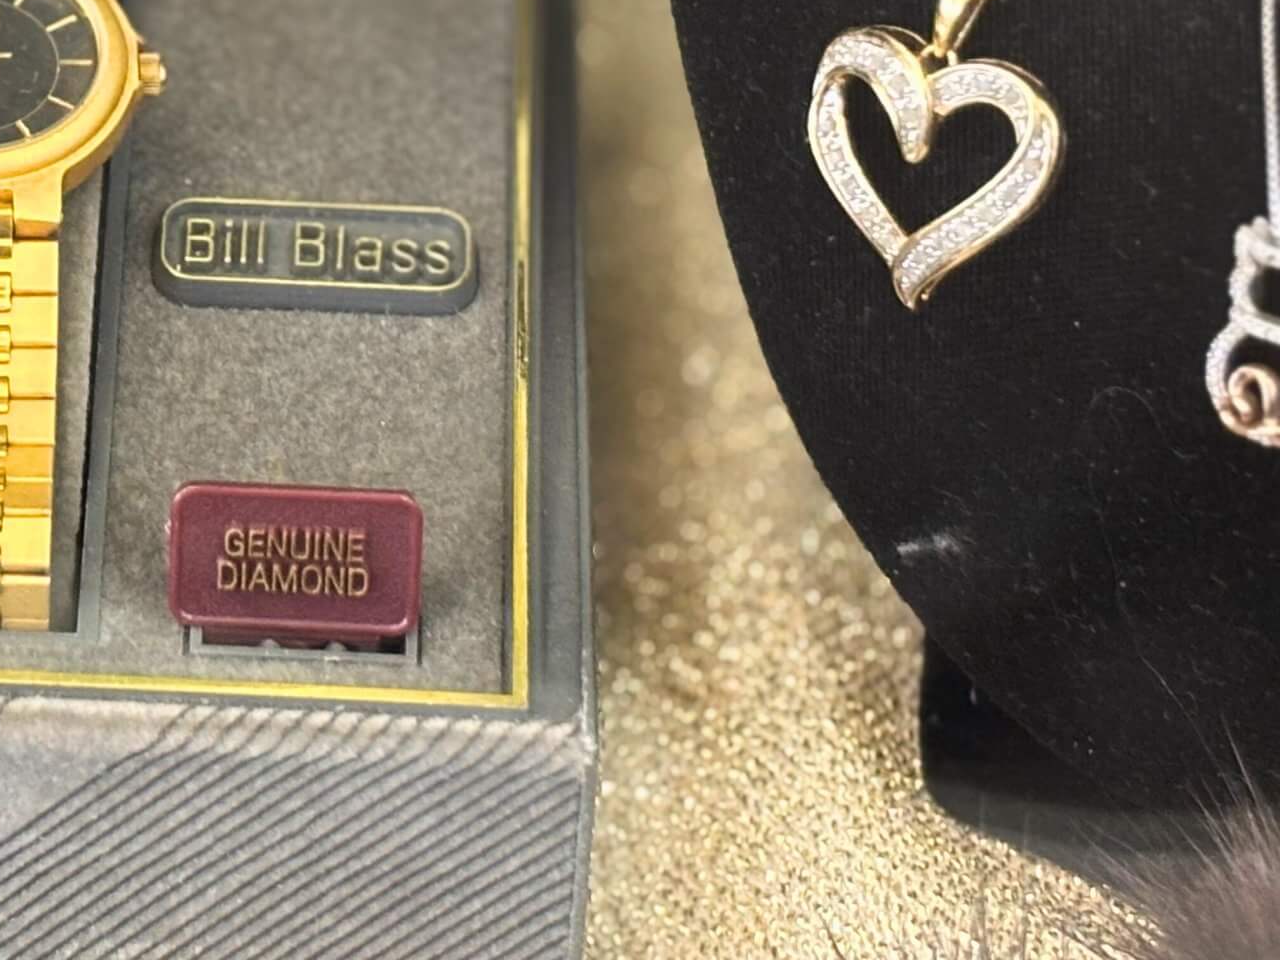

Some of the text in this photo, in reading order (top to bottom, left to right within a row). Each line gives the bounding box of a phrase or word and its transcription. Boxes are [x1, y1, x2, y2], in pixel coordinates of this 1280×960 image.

[184, 217, 452, 275] Bill Blass
[223, 526, 367, 563] GENUINE
[216, 559, 369, 597] DIAMOND
